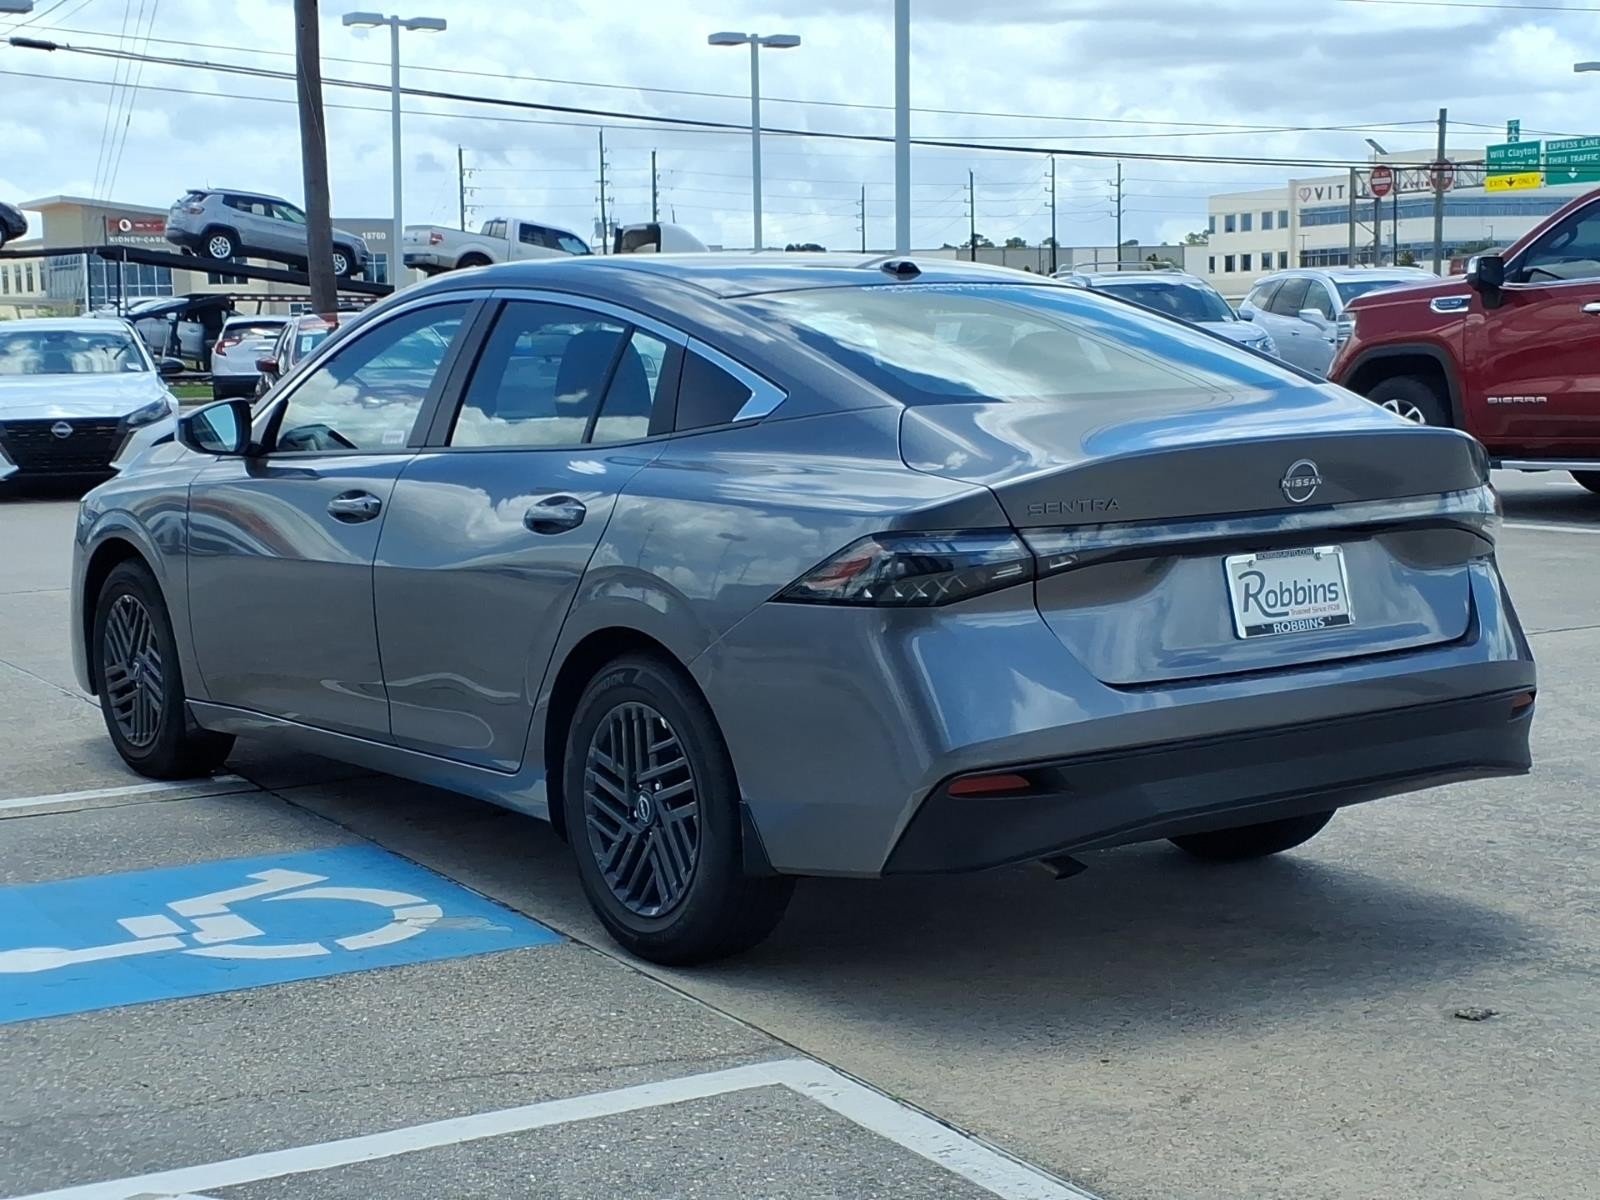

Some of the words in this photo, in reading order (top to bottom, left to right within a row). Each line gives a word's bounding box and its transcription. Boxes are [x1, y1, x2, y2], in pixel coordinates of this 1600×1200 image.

[1548, 141, 1577, 150] EXPRESS
[1490, 149, 1505, 159] Will
[1508, 147, 1537, 158] Clayton
[1549, 156, 1567, 164] THRU
[1570, 153, 1599, 162] TRAFFIC
[1518, 177, 1537, 185] ONLY
[109, 236, 141, 244] KIDNEY
[1487, 396, 1548, 404] SIERRA
[1282, 478, 1322, 488] NISSAN
[1027, 498, 1120, 517] SENTRA
[1238, 570, 1340, 618] Robbins
[1311, 605, 1326, 613] Since
[1273, 617, 1326, 634] ROBBINS
